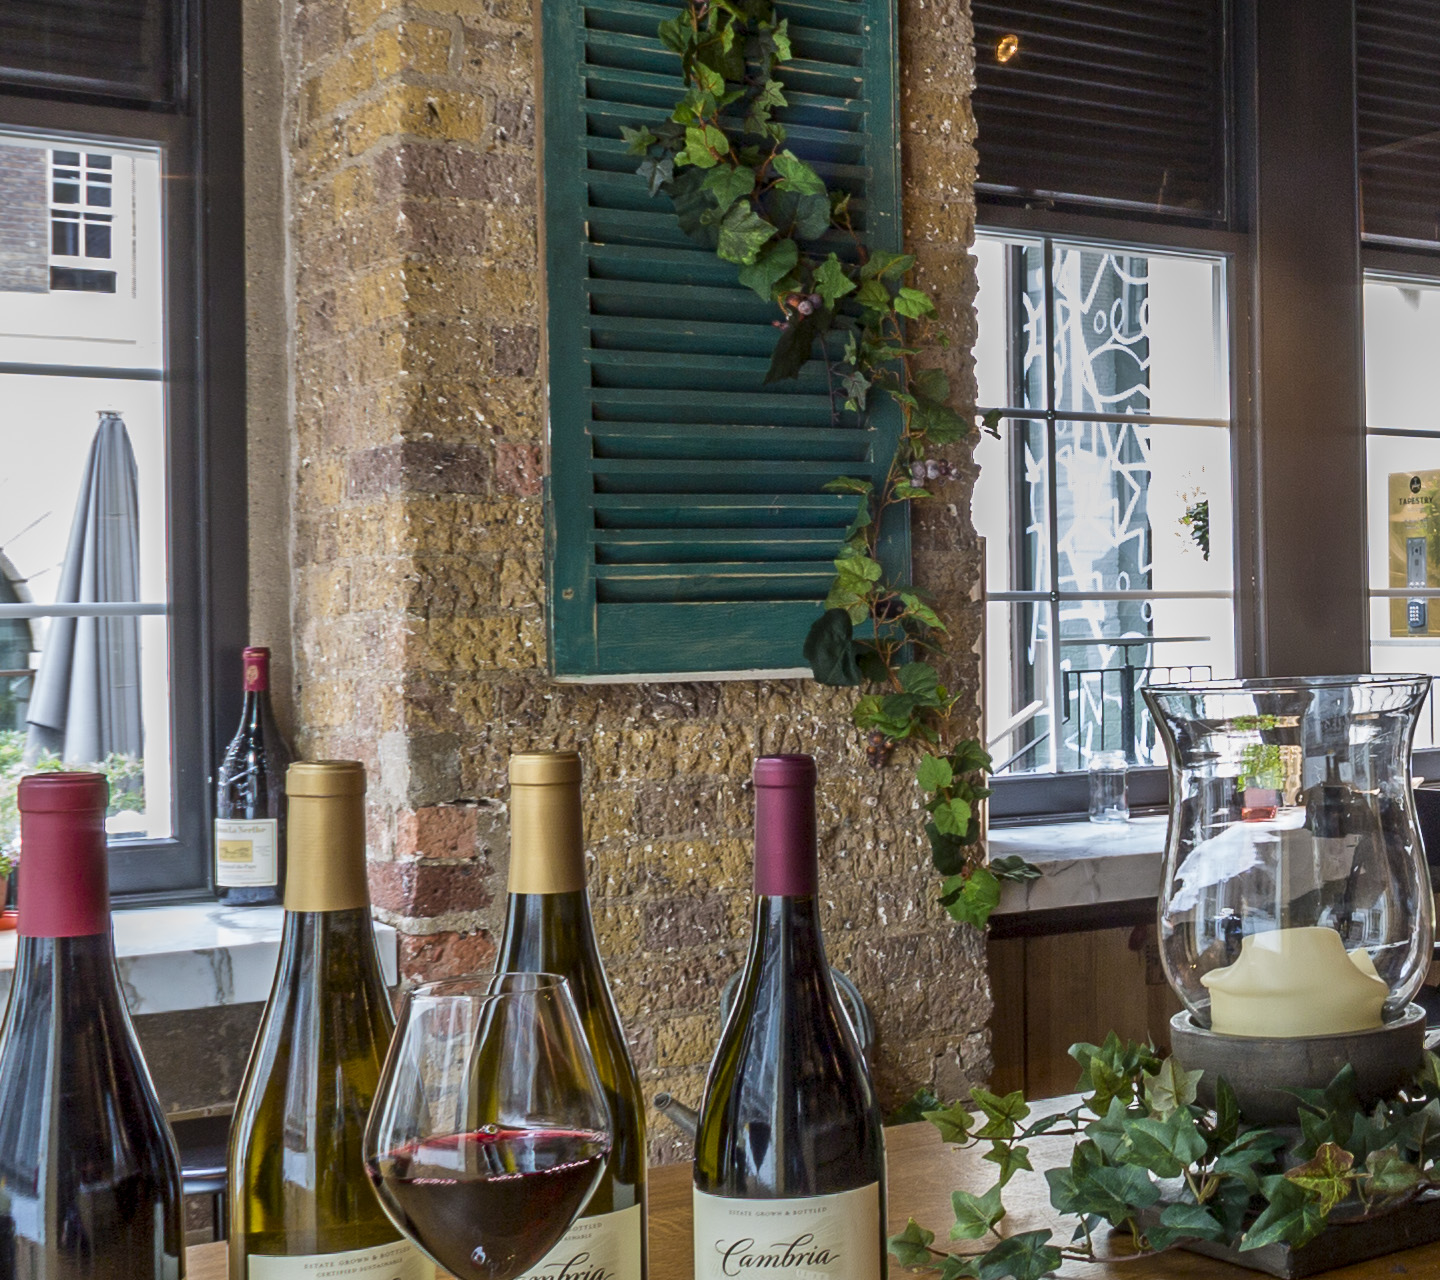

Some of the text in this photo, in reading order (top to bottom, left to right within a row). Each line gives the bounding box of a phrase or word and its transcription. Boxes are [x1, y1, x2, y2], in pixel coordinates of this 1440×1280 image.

[1399, 496, 1435, 506] TAPESTRY
[567, 1222, 603, 1232] OTTLED
[714, 1232, 841, 1277] Cambria
